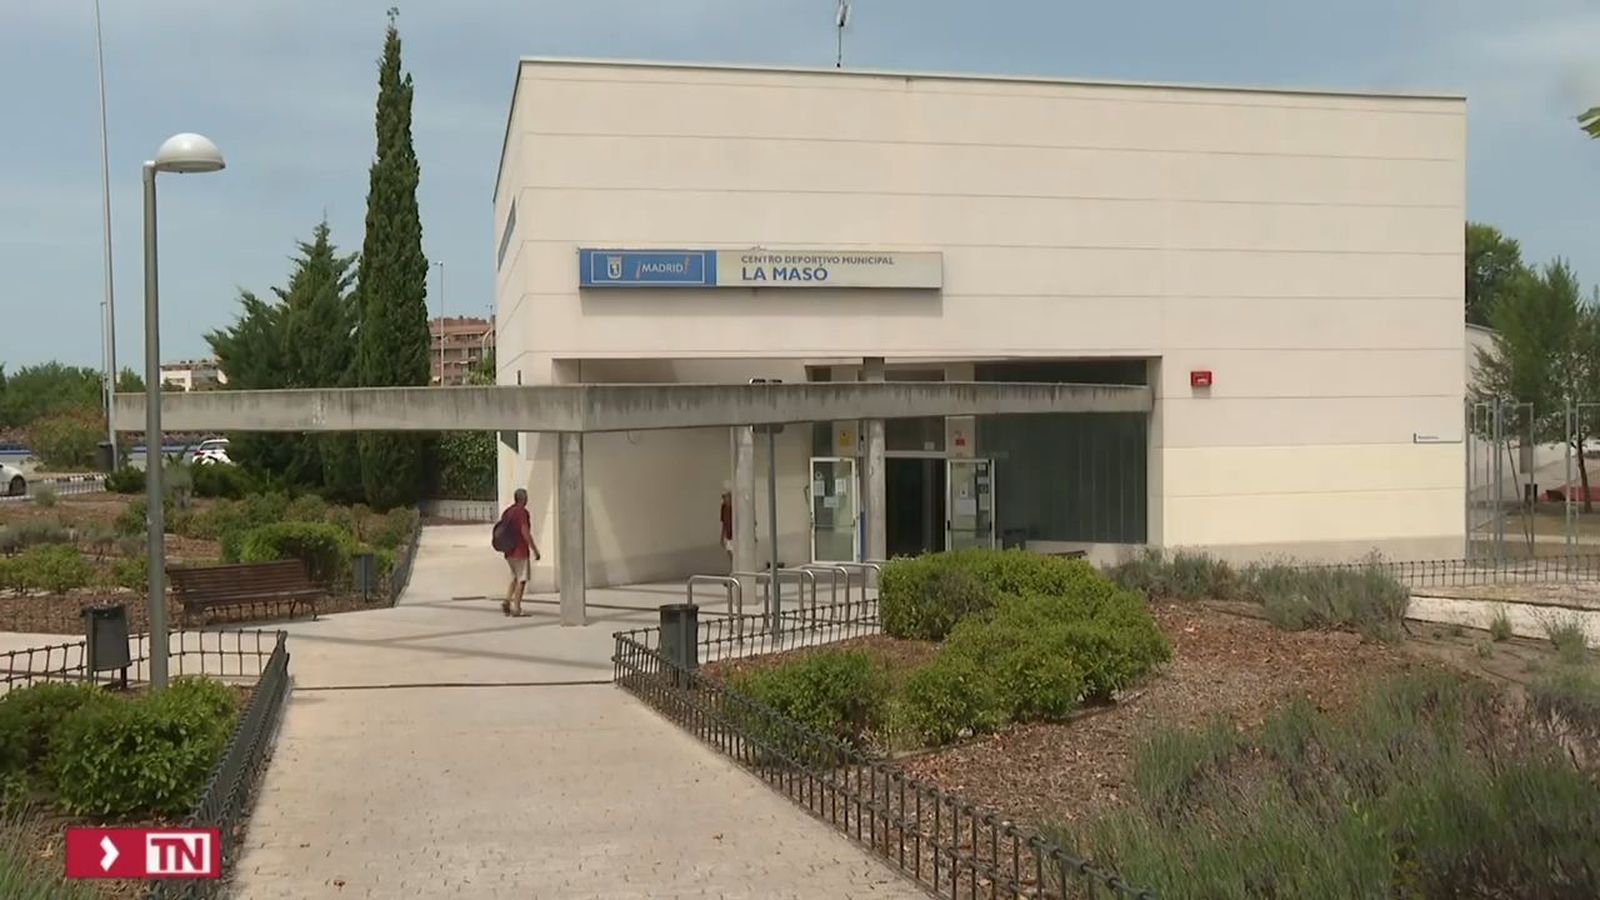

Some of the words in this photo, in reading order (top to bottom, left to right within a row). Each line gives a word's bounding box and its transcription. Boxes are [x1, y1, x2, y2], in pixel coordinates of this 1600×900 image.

[741, 255, 783, 264] CENTRO
[784, 255, 840, 264] DEPORTIVO
[842, 256, 895, 265] MUNICIPAL
[742, 267, 767, 281] LA
[772, 263, 828, 281] MASÓ
